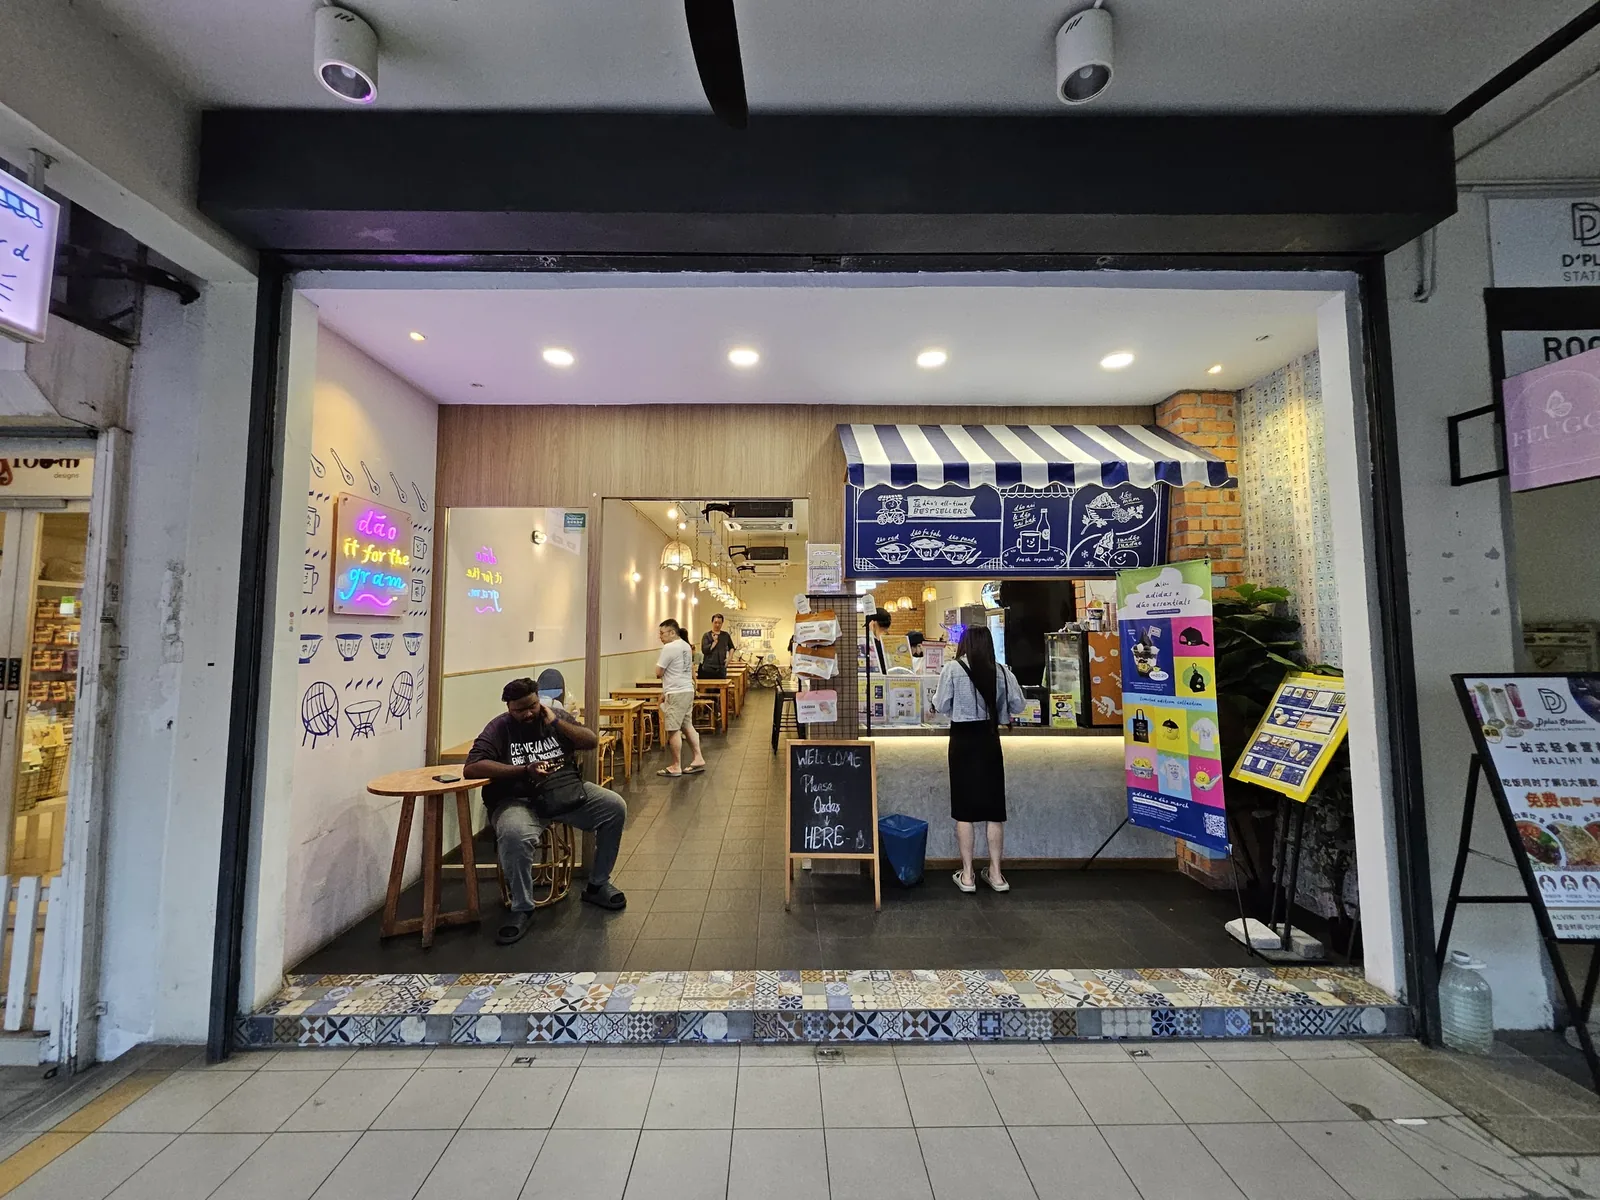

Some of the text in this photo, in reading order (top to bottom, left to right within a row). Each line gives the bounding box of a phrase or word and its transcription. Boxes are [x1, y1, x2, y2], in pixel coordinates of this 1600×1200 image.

[913, 507, 968, 515] BESTSELLERS
[343, 537, 410, 566] it for the
[339, 567, 407, 600] gram
[1145, 591, 1173, 599] adidas
[1152, 597, 1191, 608] essentials
[1532, 756, 1583, 765] HEALTHY
[801, 774, 834, 794] Please
